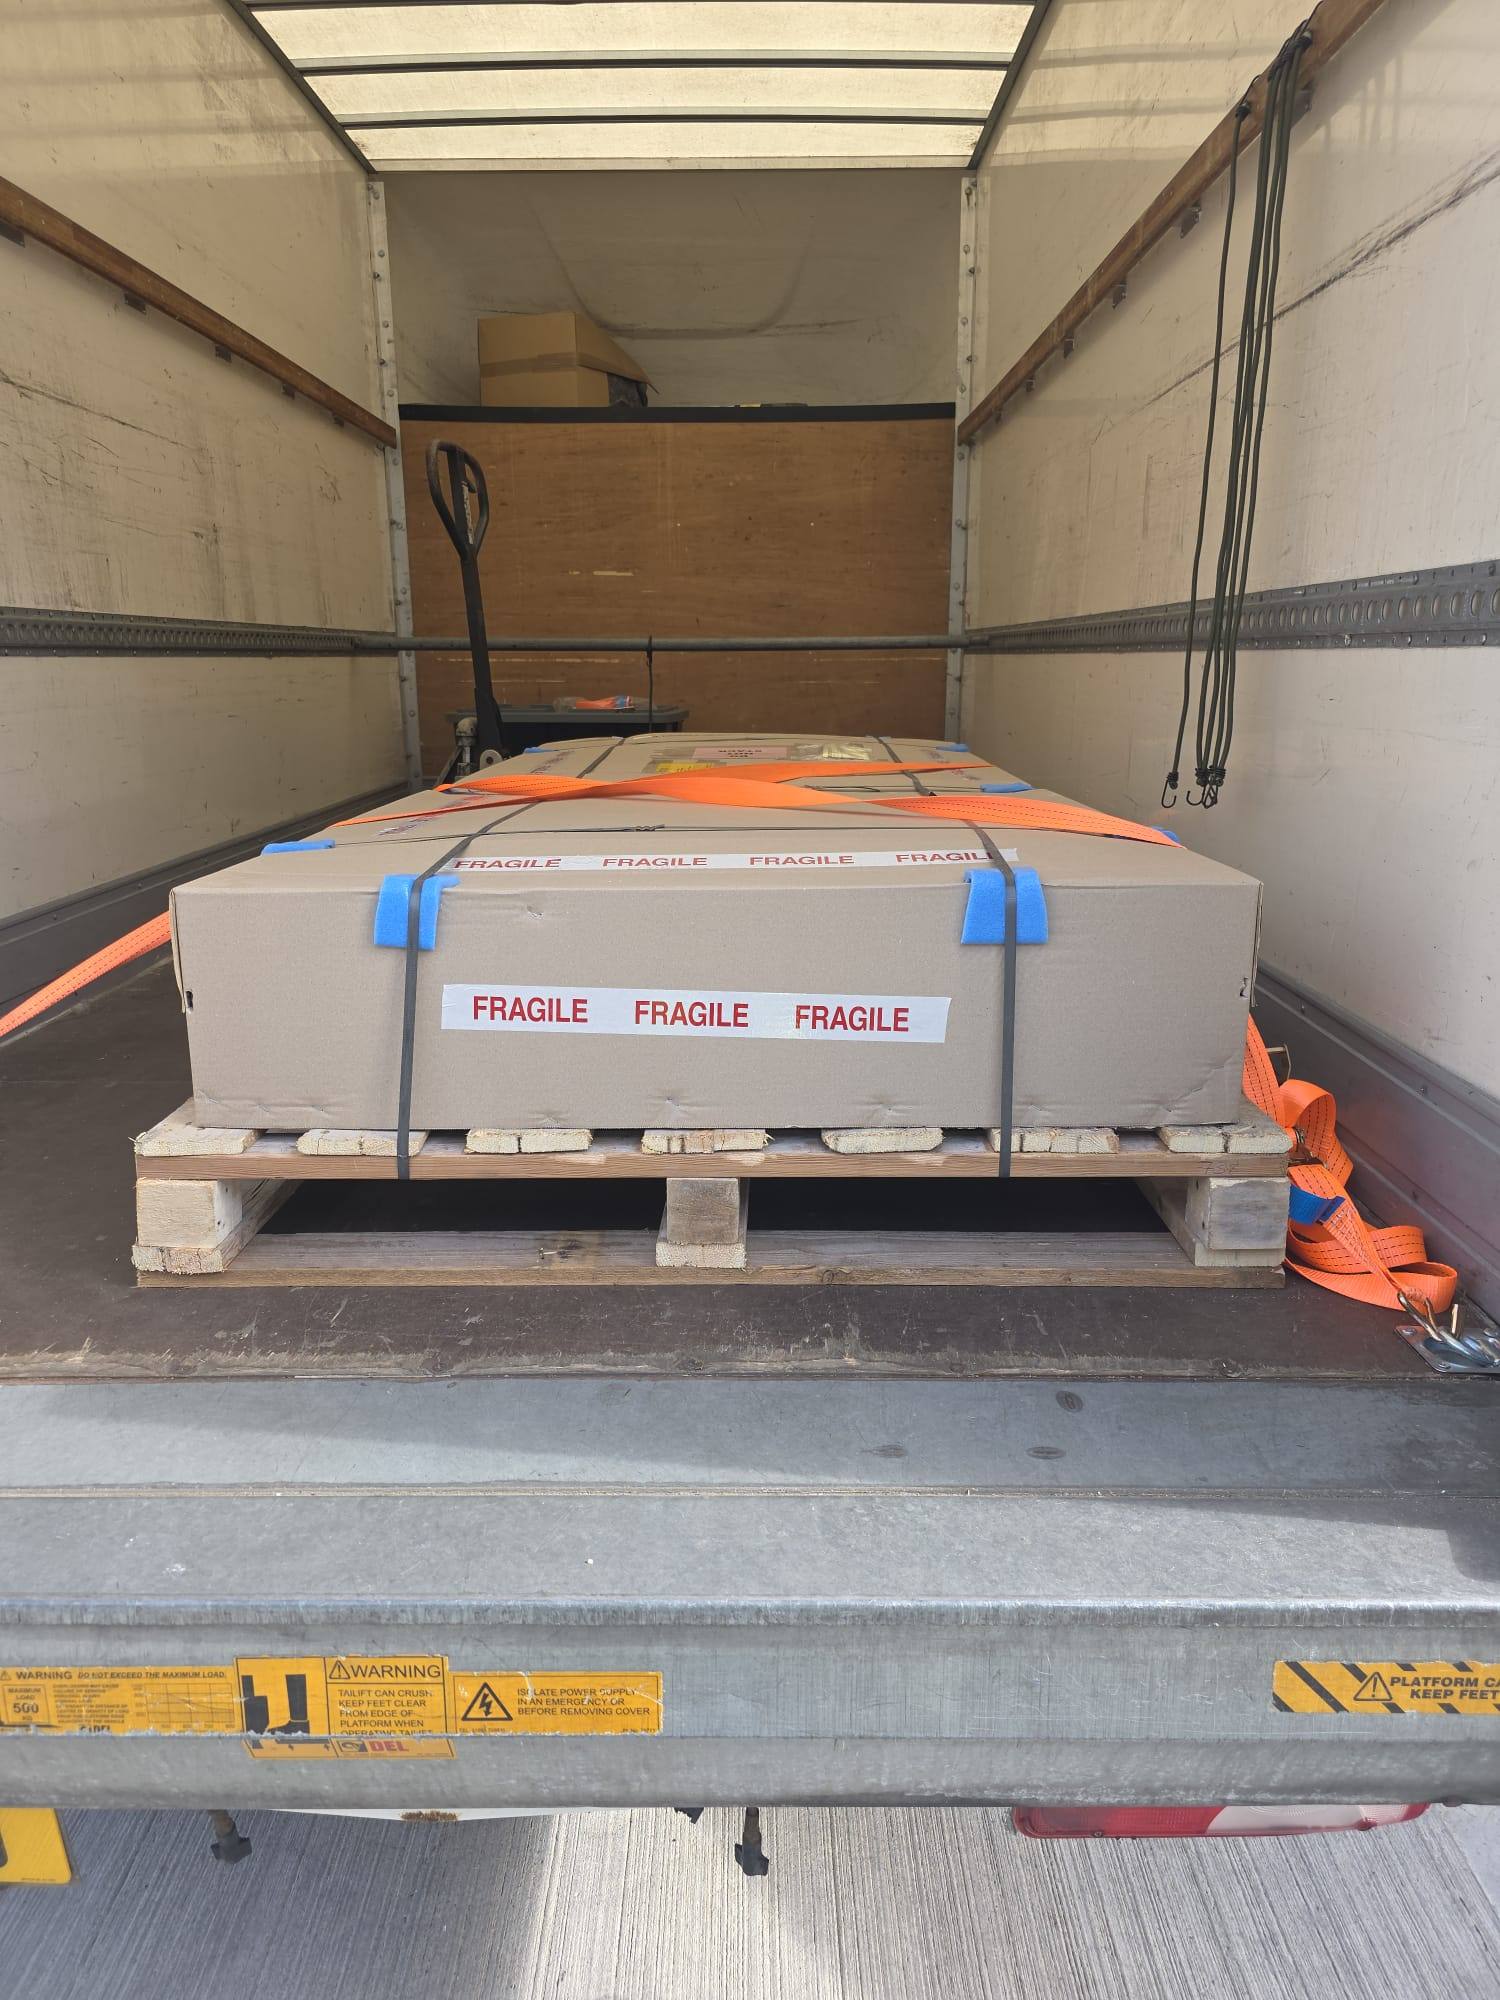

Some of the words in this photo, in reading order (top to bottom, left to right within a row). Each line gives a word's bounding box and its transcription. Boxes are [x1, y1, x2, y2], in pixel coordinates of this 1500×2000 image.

[454, 857, 562, 869] FRAGILE
[602, 857, 708, 867] FRAGILE
[749, 854, 855, 866] FRAGILE
[472, 995, 588, 1024] FRAGILE
[634, 1000, 749, 1029] FRAGILE
[795, 1004, 909, 1033] FRAGILE
[16, 1671, 73, 1680] WARNING
[145, 1671, 160, 1679] THE
[162, 1671, 200, 1679] MAXIMUM
[349, 1664, 441, 1679] WARNING
[1390, 1676, 1479, 1687] PLATFORM
[338, 1689, 371, 1697] TAILIFT
[374, 1689, 395, 1697] CAN
[517, 1688, 558, 1696] ISOLATE
[560, 1688, 597, 1696] POWER
[599, 1688, 637, 1696] SUPPLY
[1410, 1688, 1453, 1699] KEEP
[1459, 1689, 1500, 1700] FEET
[517, 1698, 530, 1706] IN
[530, 1698, 544, 1706] AN
[545, 1698, 608, 1706] EMERGENCY
[609, 1698, 625, 1706] OR
[13, 1702, 39, 1714] 500
[518, 1707, 558, 1715] BEFORE
[560, 1707, 613, 1715] REMOVING
[615, 1707, 650, 1715] COVER
[340, 1709, 369, 1718] FROM
[371, 1709, 398, 1717] EDGE
[400, 1709, 414, 1717] OF
[341, 1719, 392, 1728] PLATFORM
[394, 1719, 424, 1727] WHEN
[368, 1740, 409, 1752] DEL
